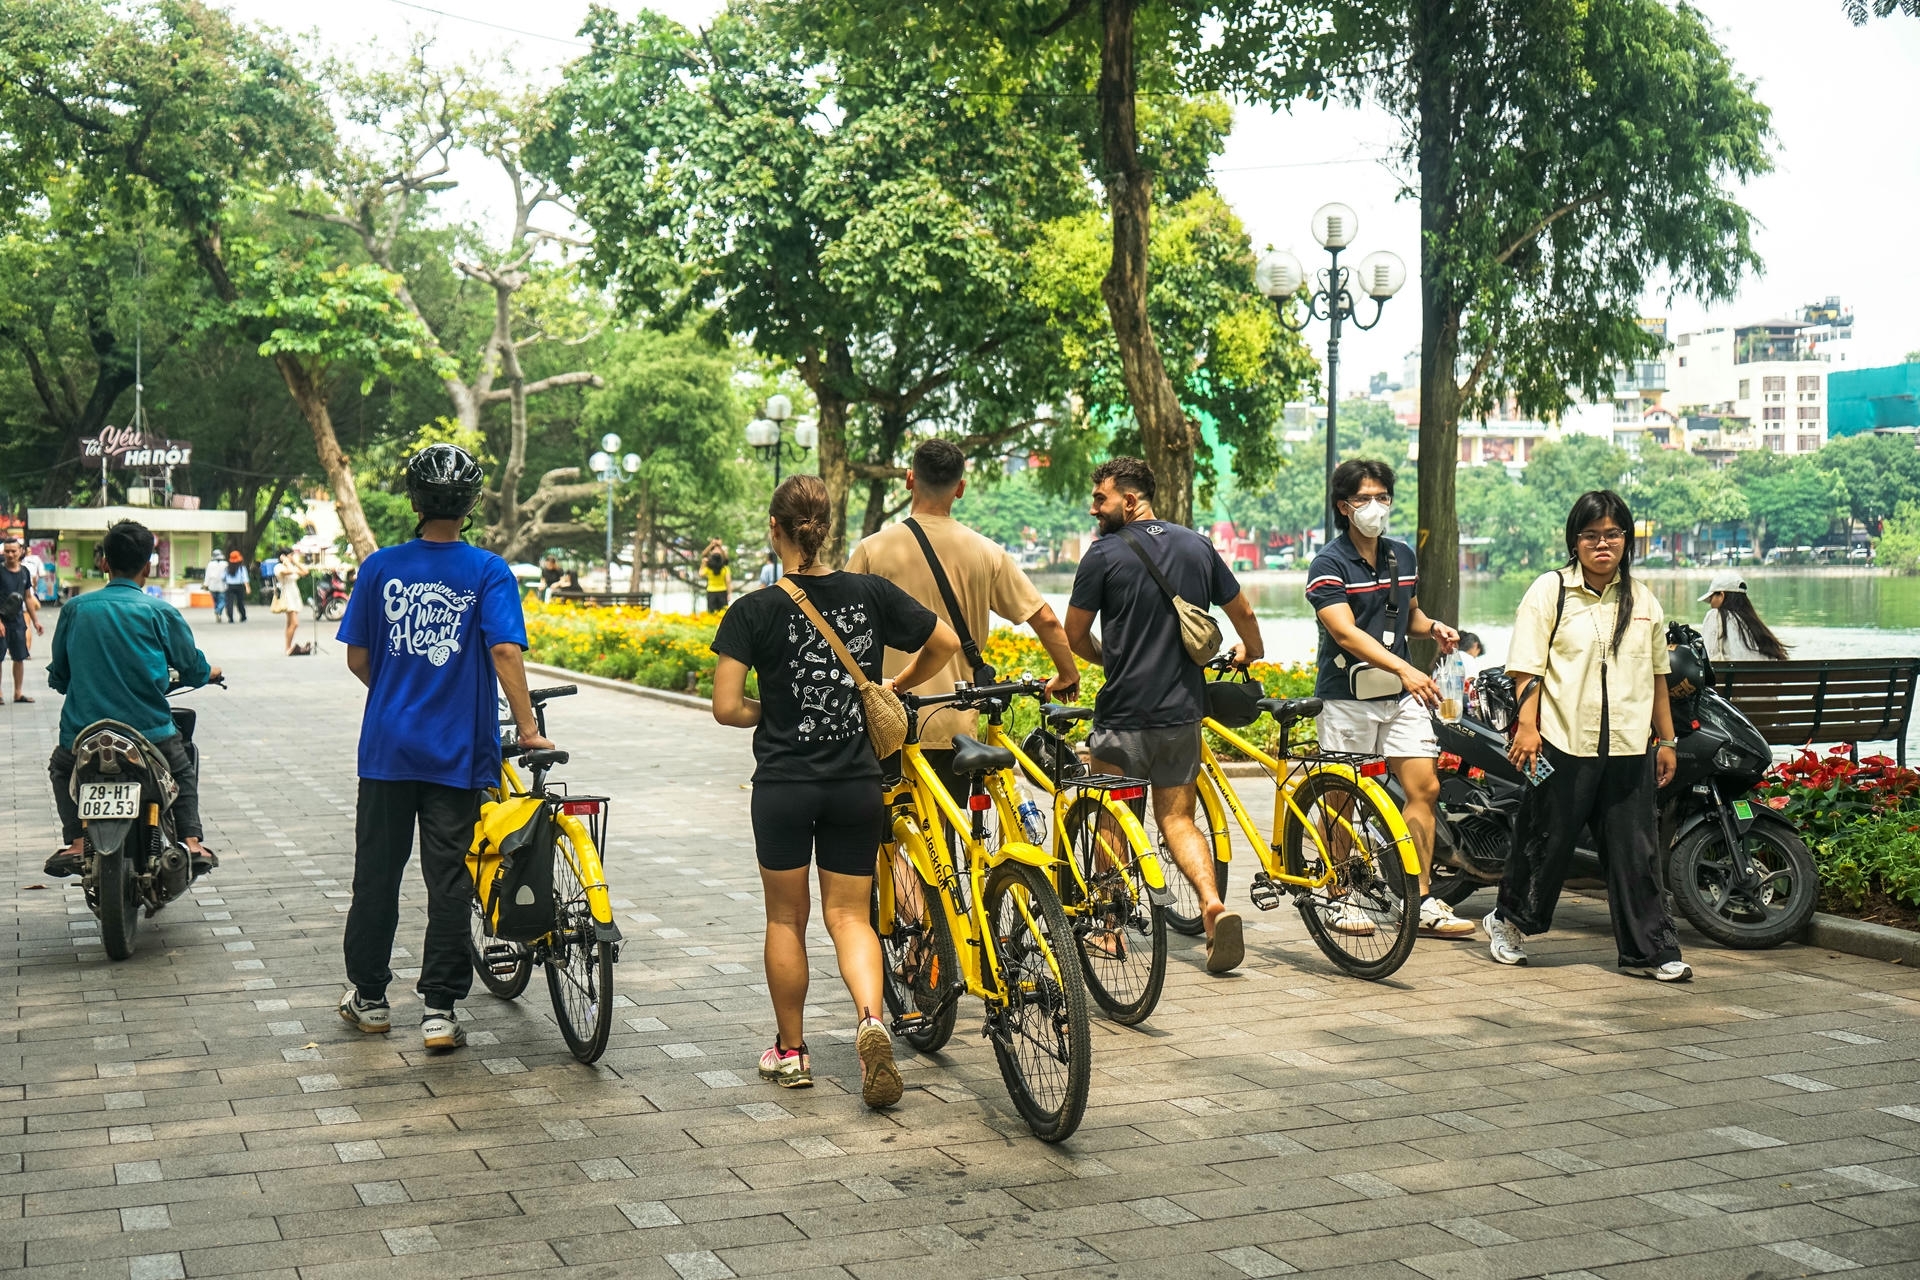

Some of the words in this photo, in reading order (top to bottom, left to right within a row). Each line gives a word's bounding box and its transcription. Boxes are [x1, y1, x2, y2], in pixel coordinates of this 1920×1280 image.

[81, 438, 105, 457] Tôi
[99, 424, 142, 455] Yêu
[383, 578, 472, 622] Experiences
[822, 603, 864, 617] OCEAN
[408, 602, 453, 629] With
[389, 612, 462, 654] Heart
[89, 785, 130, 800] 29-H1
[83, 801, 134, 816] 082.53
[925, 836, 947, 893] Jackfruit
